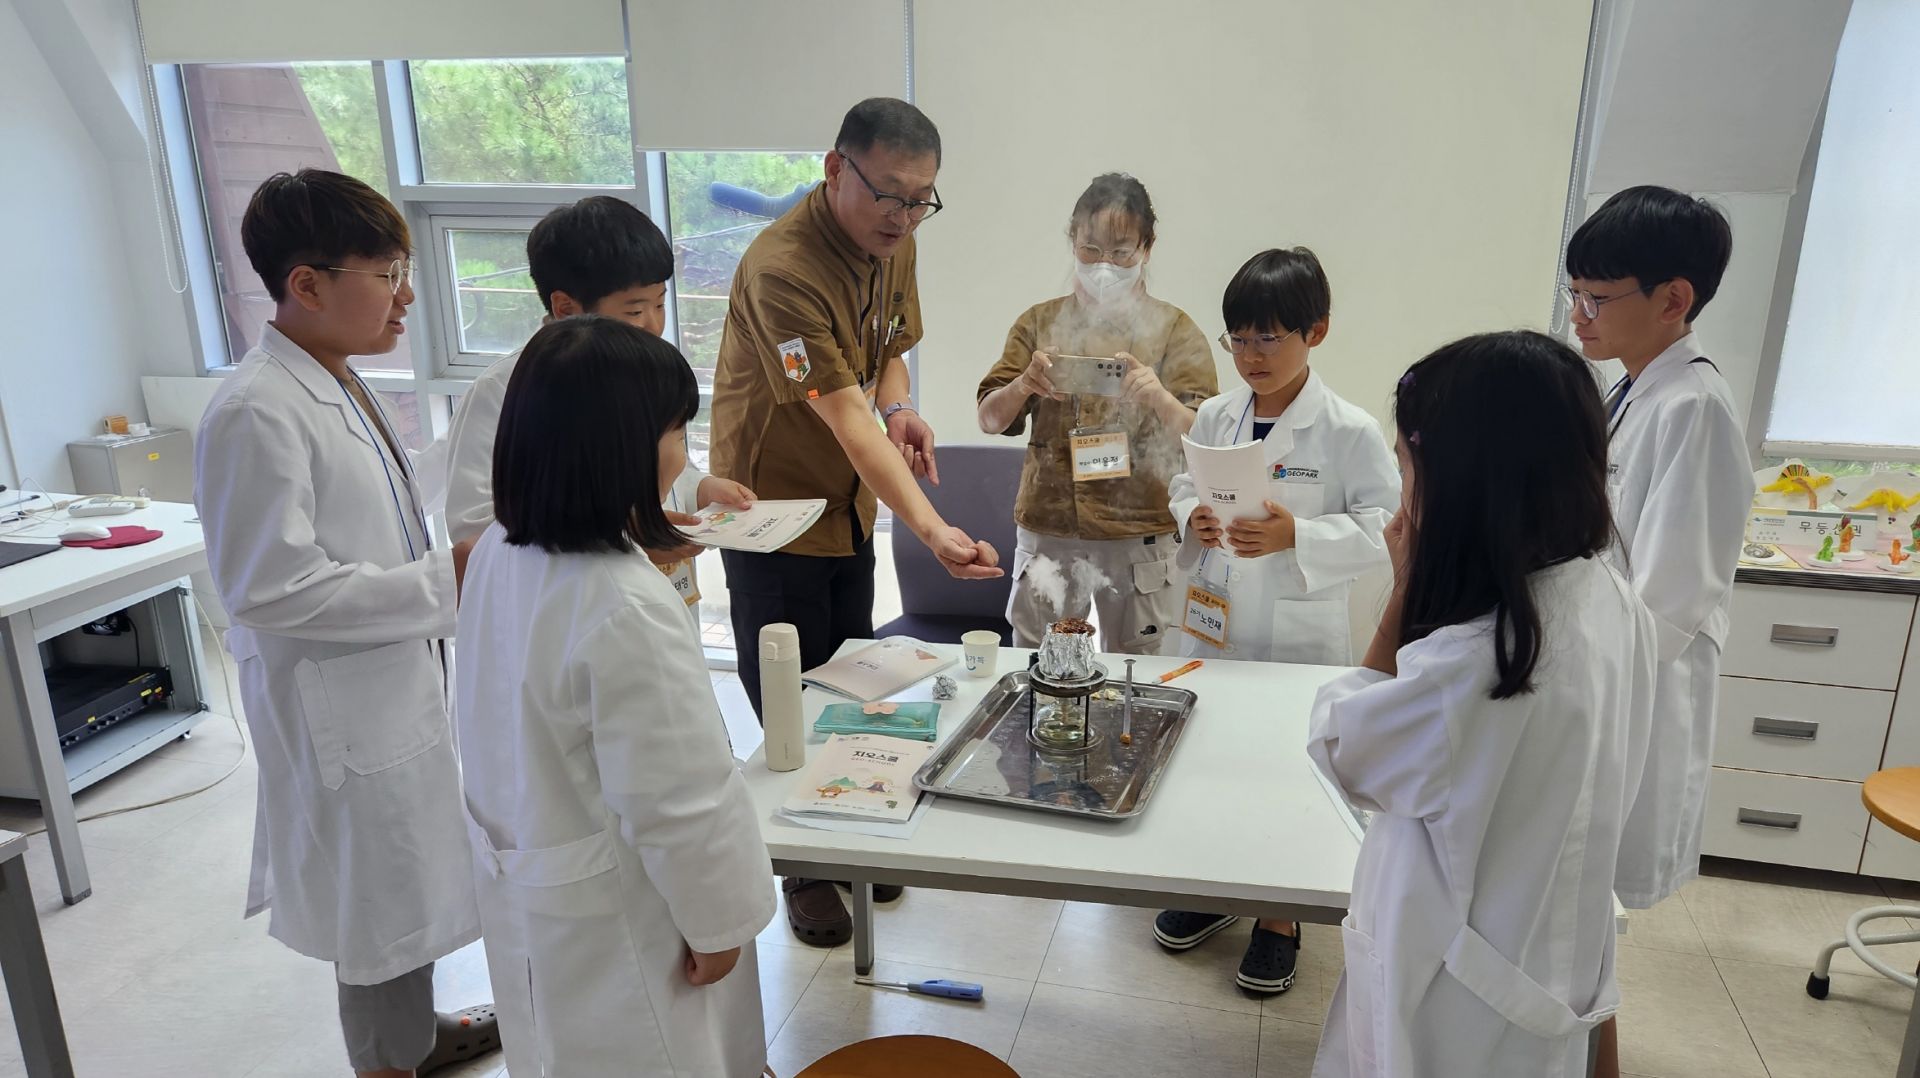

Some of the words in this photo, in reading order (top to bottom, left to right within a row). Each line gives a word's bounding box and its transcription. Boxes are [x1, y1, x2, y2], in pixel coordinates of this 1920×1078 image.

[1286, 470, 1318, 478] GEOPARK
[1211, 492, 1236, 501] 지오스쿨
[674, 576, 689, 591] 태영
[852, 750, 899, 763] 지오스쿨
